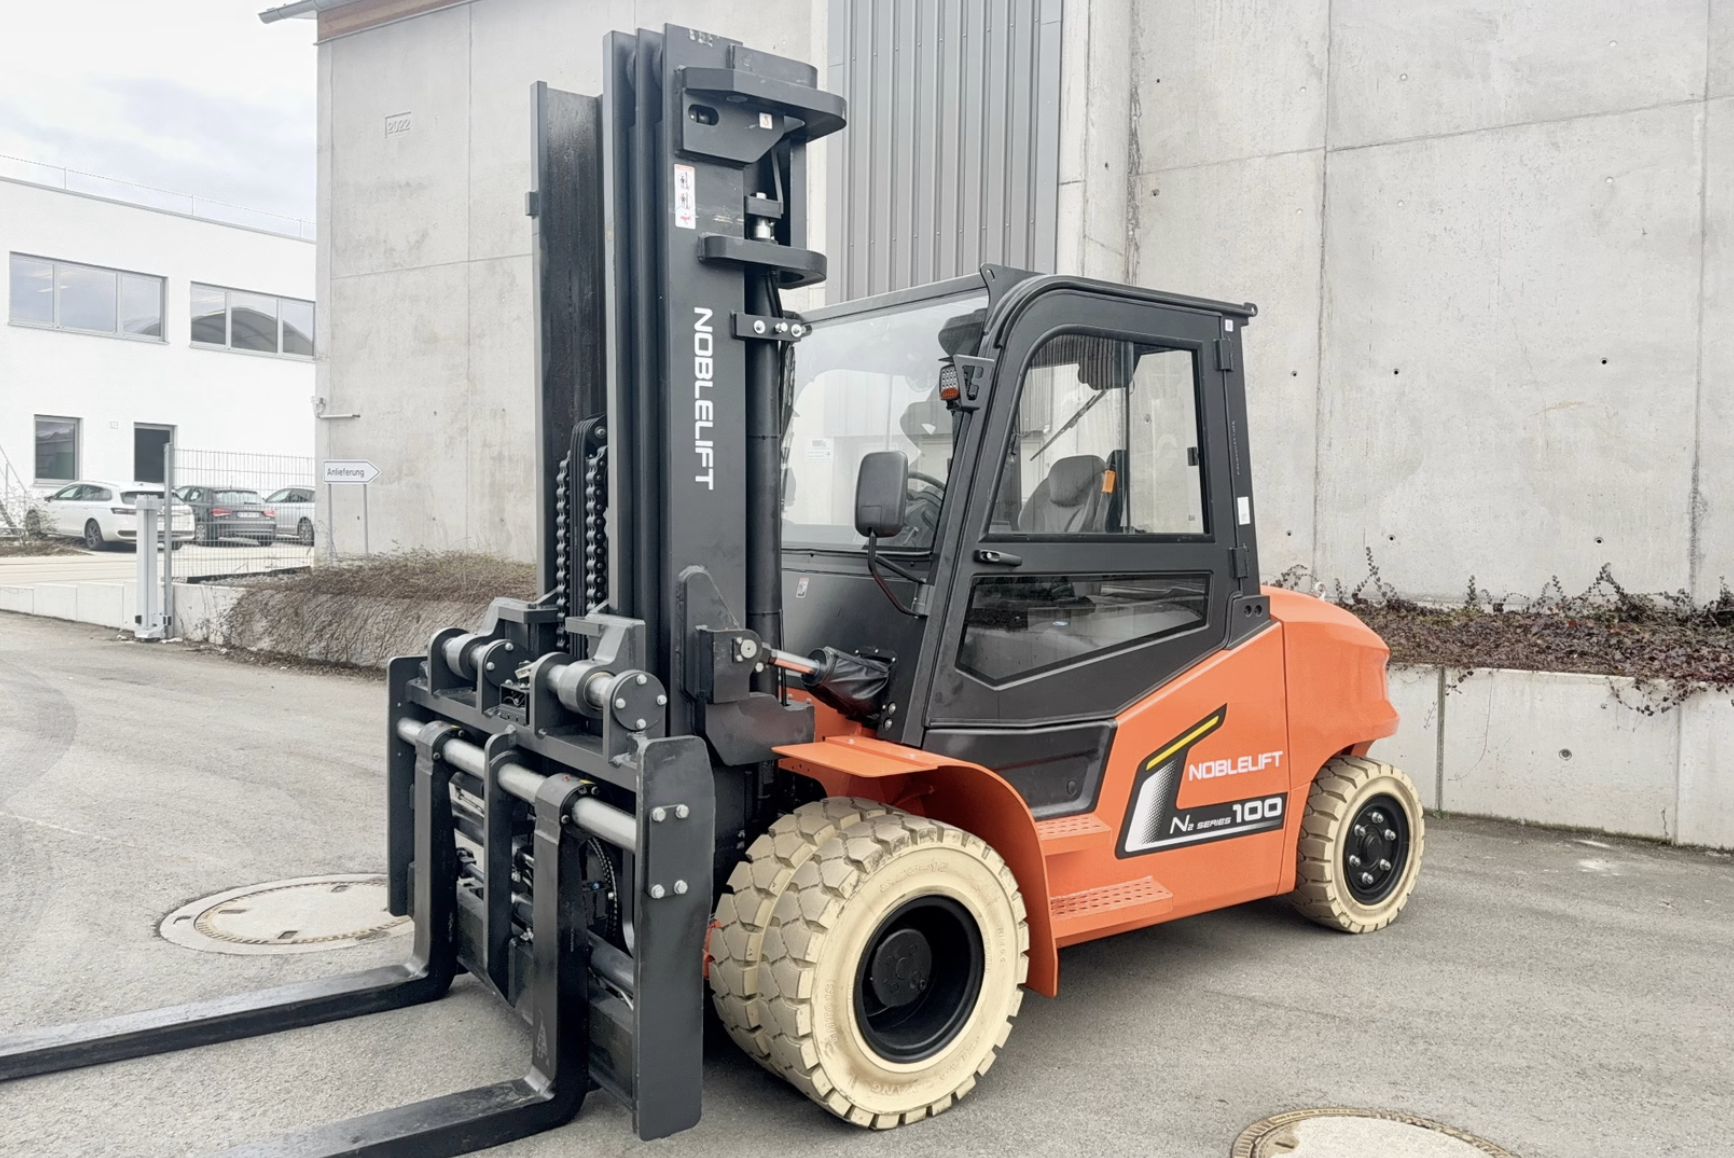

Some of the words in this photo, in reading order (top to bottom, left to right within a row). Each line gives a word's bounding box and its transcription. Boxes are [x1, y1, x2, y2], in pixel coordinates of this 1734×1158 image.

[387, 119, 411, 135] 2022
[694, 306, 714, 491] NOBLELIFT
[326, 467, 366, 479] Anlieferung
[1188, 750, 1284, 782] NOBLELIFT
[1196, 816, 1232, 830] SERIES
[1232, 797, 1283, 823] 100
